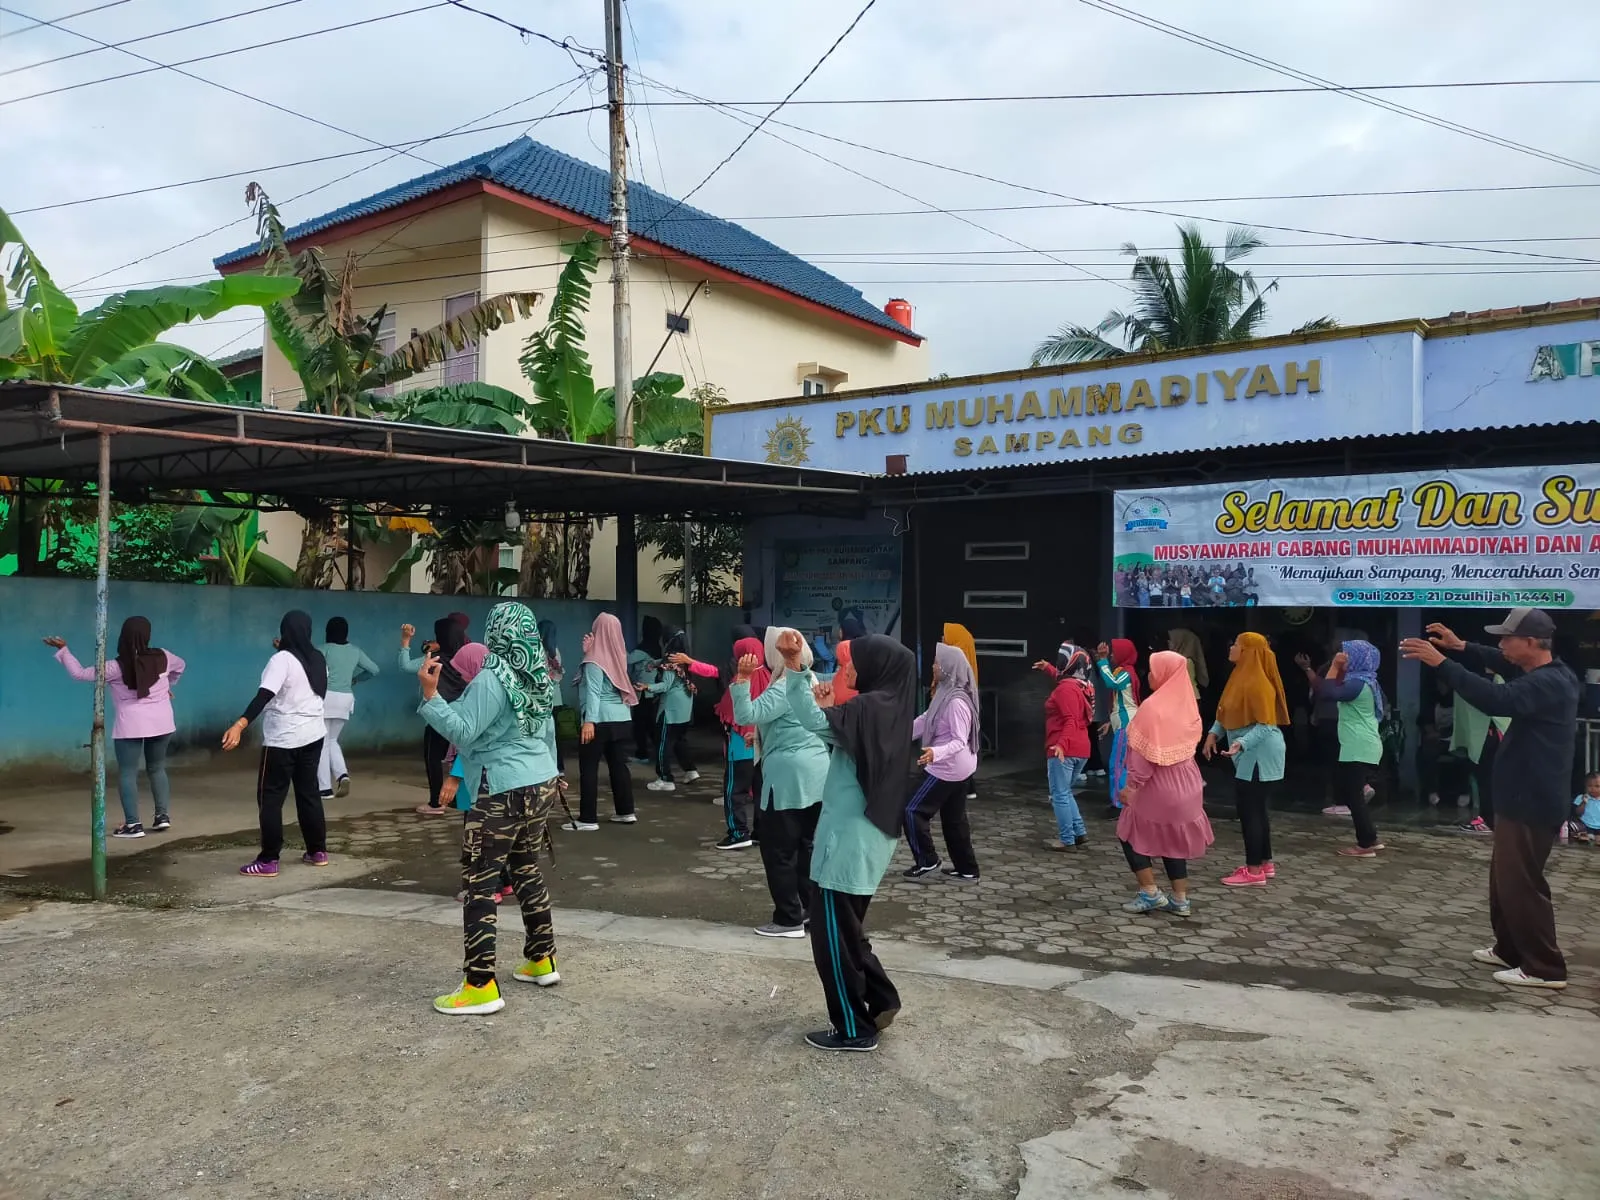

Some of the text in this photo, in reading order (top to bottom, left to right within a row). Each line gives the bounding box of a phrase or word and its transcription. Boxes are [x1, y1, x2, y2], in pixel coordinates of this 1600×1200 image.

[835, 358, 1323, 438] PKU MUHAMMADIYAH
[954, 423, 1143, 458] SAMPANG
[1215, 490, 1404, 533] Selamat
[1411, 480, 1523, 528] Dan
[1153, 541, 1271, 561] MUSYAWARAH
[1276, 539, 1350, 557] CABANG
[1356, 535, 1528, 556] MUHAMMADIYAH
[1534, 534, 1582, 553] DAN
[1367, 564, 1446, 583] Sampang,
[1451, 563, 1564, 579] Mencerahkan
[1338, 591, 1355, 601] 09
[1357, 590, 1381, 601] Juli
[1384, 591, 1415, 601] 2023
[1427, 591, 1440, 601] 21
[1444, 590, 1512, 603] Dzulhijah
[1514, 591, 1551, 602] 1444
[1554, 591, 1566, 602] H
